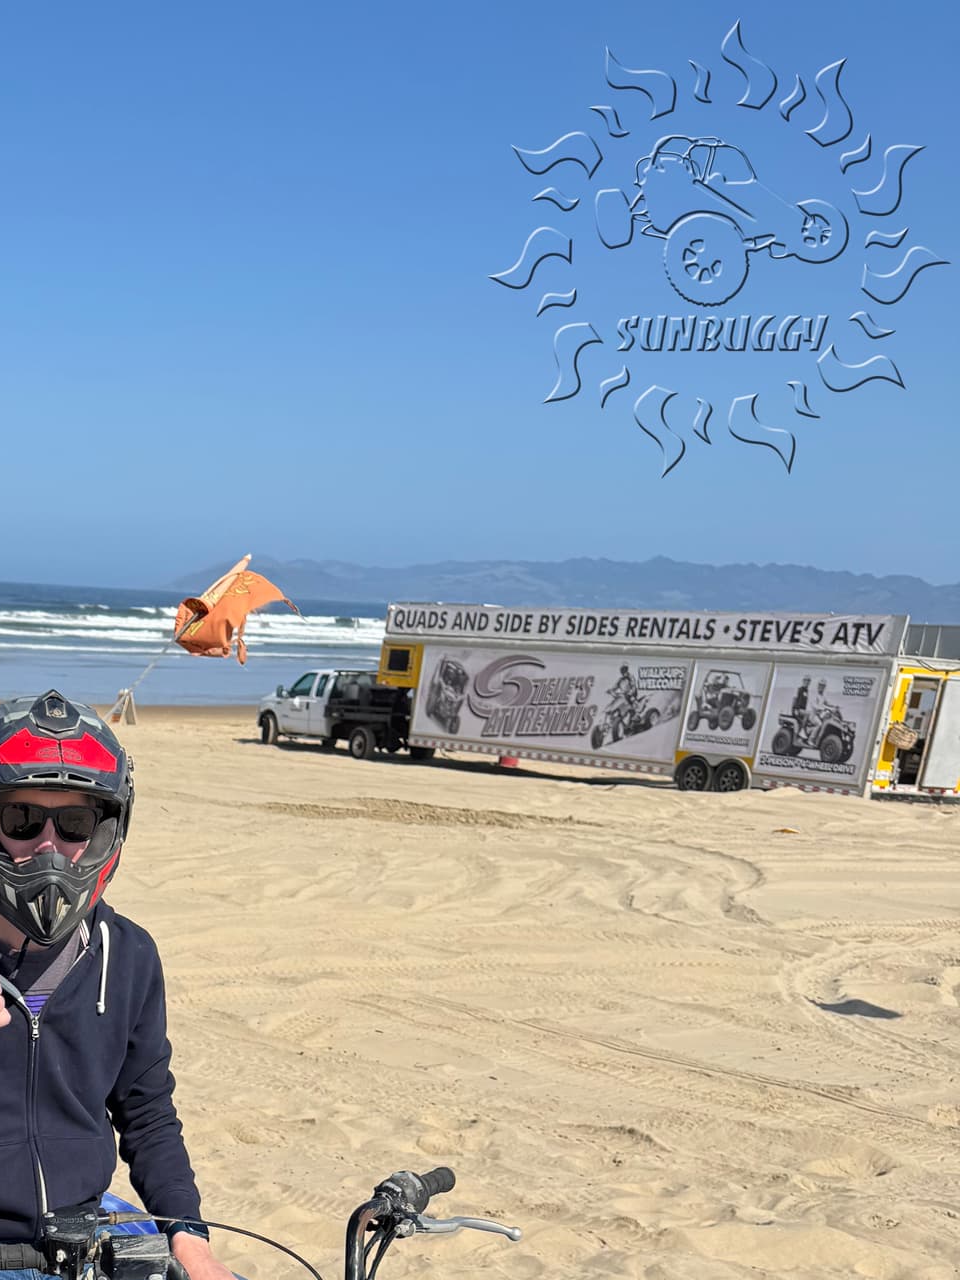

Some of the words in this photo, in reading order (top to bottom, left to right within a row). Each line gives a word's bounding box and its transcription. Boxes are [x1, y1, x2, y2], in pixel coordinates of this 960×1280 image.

[393, 609, 448, 630] QUADS
[451, 612, 490, 632] AND
[494, 612, 533, 634] SIDE
[538, 614, 562, 634] BY
[566, 615, 619, 637] SIDES
[625, 616, 717, 640] RENTALS
[733, 619, 825, 645] STEVE'S
[830, 622, 885, 646] ATV
[639, 678, 683, 690] WELCOME
